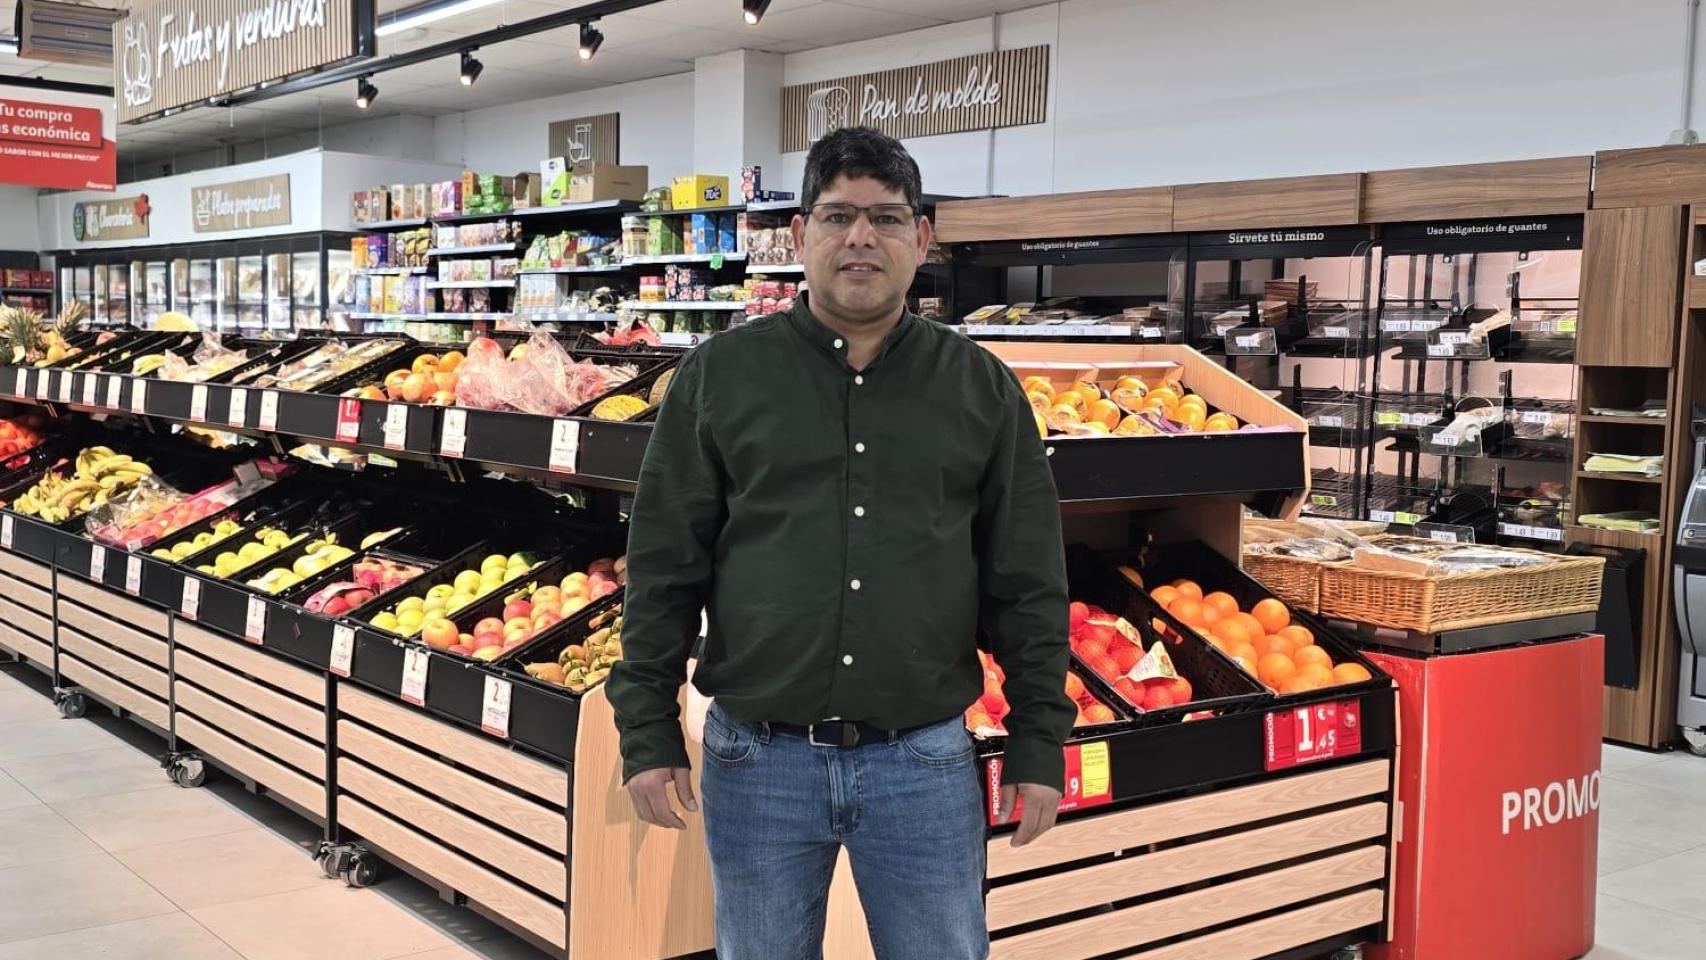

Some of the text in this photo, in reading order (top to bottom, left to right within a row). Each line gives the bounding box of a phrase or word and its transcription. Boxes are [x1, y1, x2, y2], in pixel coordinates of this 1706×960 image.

[157, 0, 327, 91] Frutas y verduras
[859, 65, 1002, 123] Pan de molde
[17, 108, 73, 123] compra
[12, 125, 91, 141] económica
[1228, 230, 1324, 243] Sírvete tú mismo
[1426, 223, 1548, 236] Uso obligatorio de guantes
[1034, 241, 1065, 251] obligatorio
[1067, 240, 1074, 249] de
[1074, 240, 1099, 249] guantes
[1266, 712, 1275, 762] PROMOCIÓN
[1070, 776, 1079, 796] 9
[1502, 769, 1601, 835] PROMO
